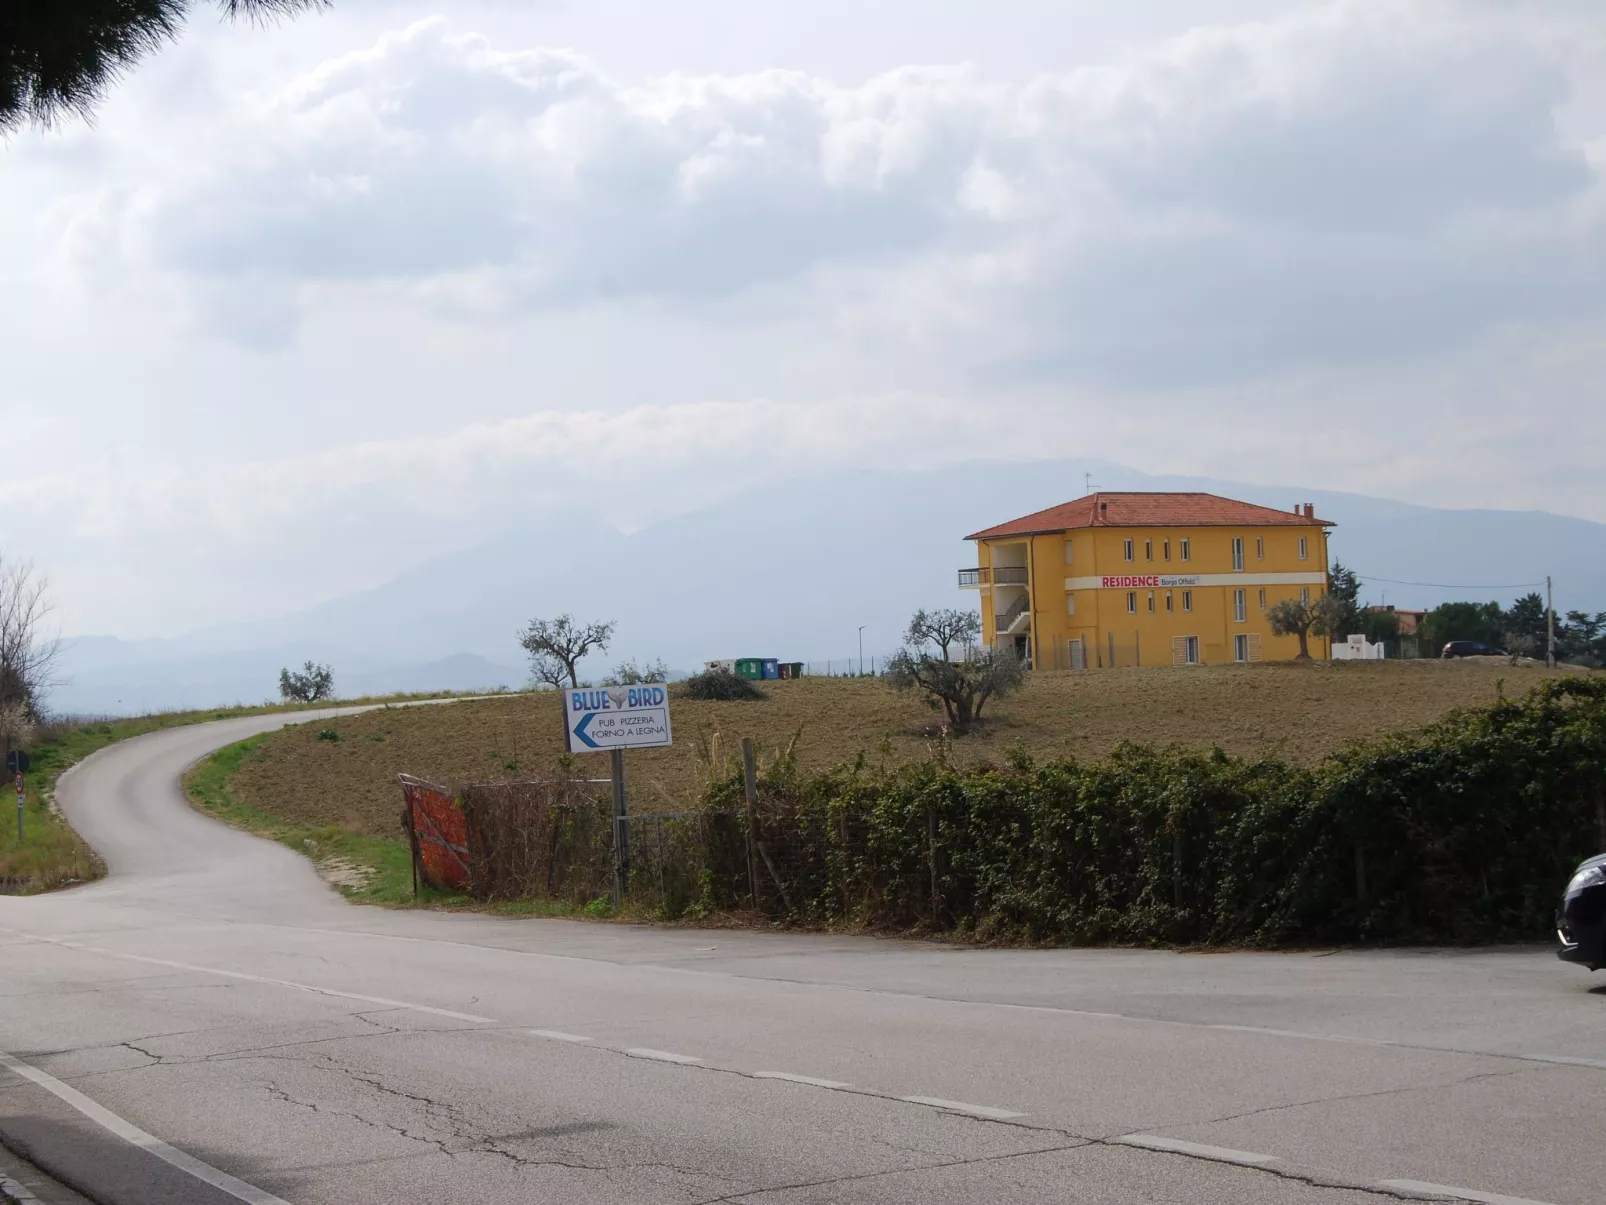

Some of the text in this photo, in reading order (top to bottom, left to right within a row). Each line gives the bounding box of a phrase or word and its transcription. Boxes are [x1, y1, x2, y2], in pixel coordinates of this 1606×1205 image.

[1102, 576, 1159, 587] RESIDENCE
[1161, 578, 1177, 587] Borgo
[572, 688, 664, 711] BLUE BIRD
[598, 717, 654, 727] PUB PIZZERIA
[592, 729, 625, 738] FORNO
[636, 726, 665, 735] LEGNA
